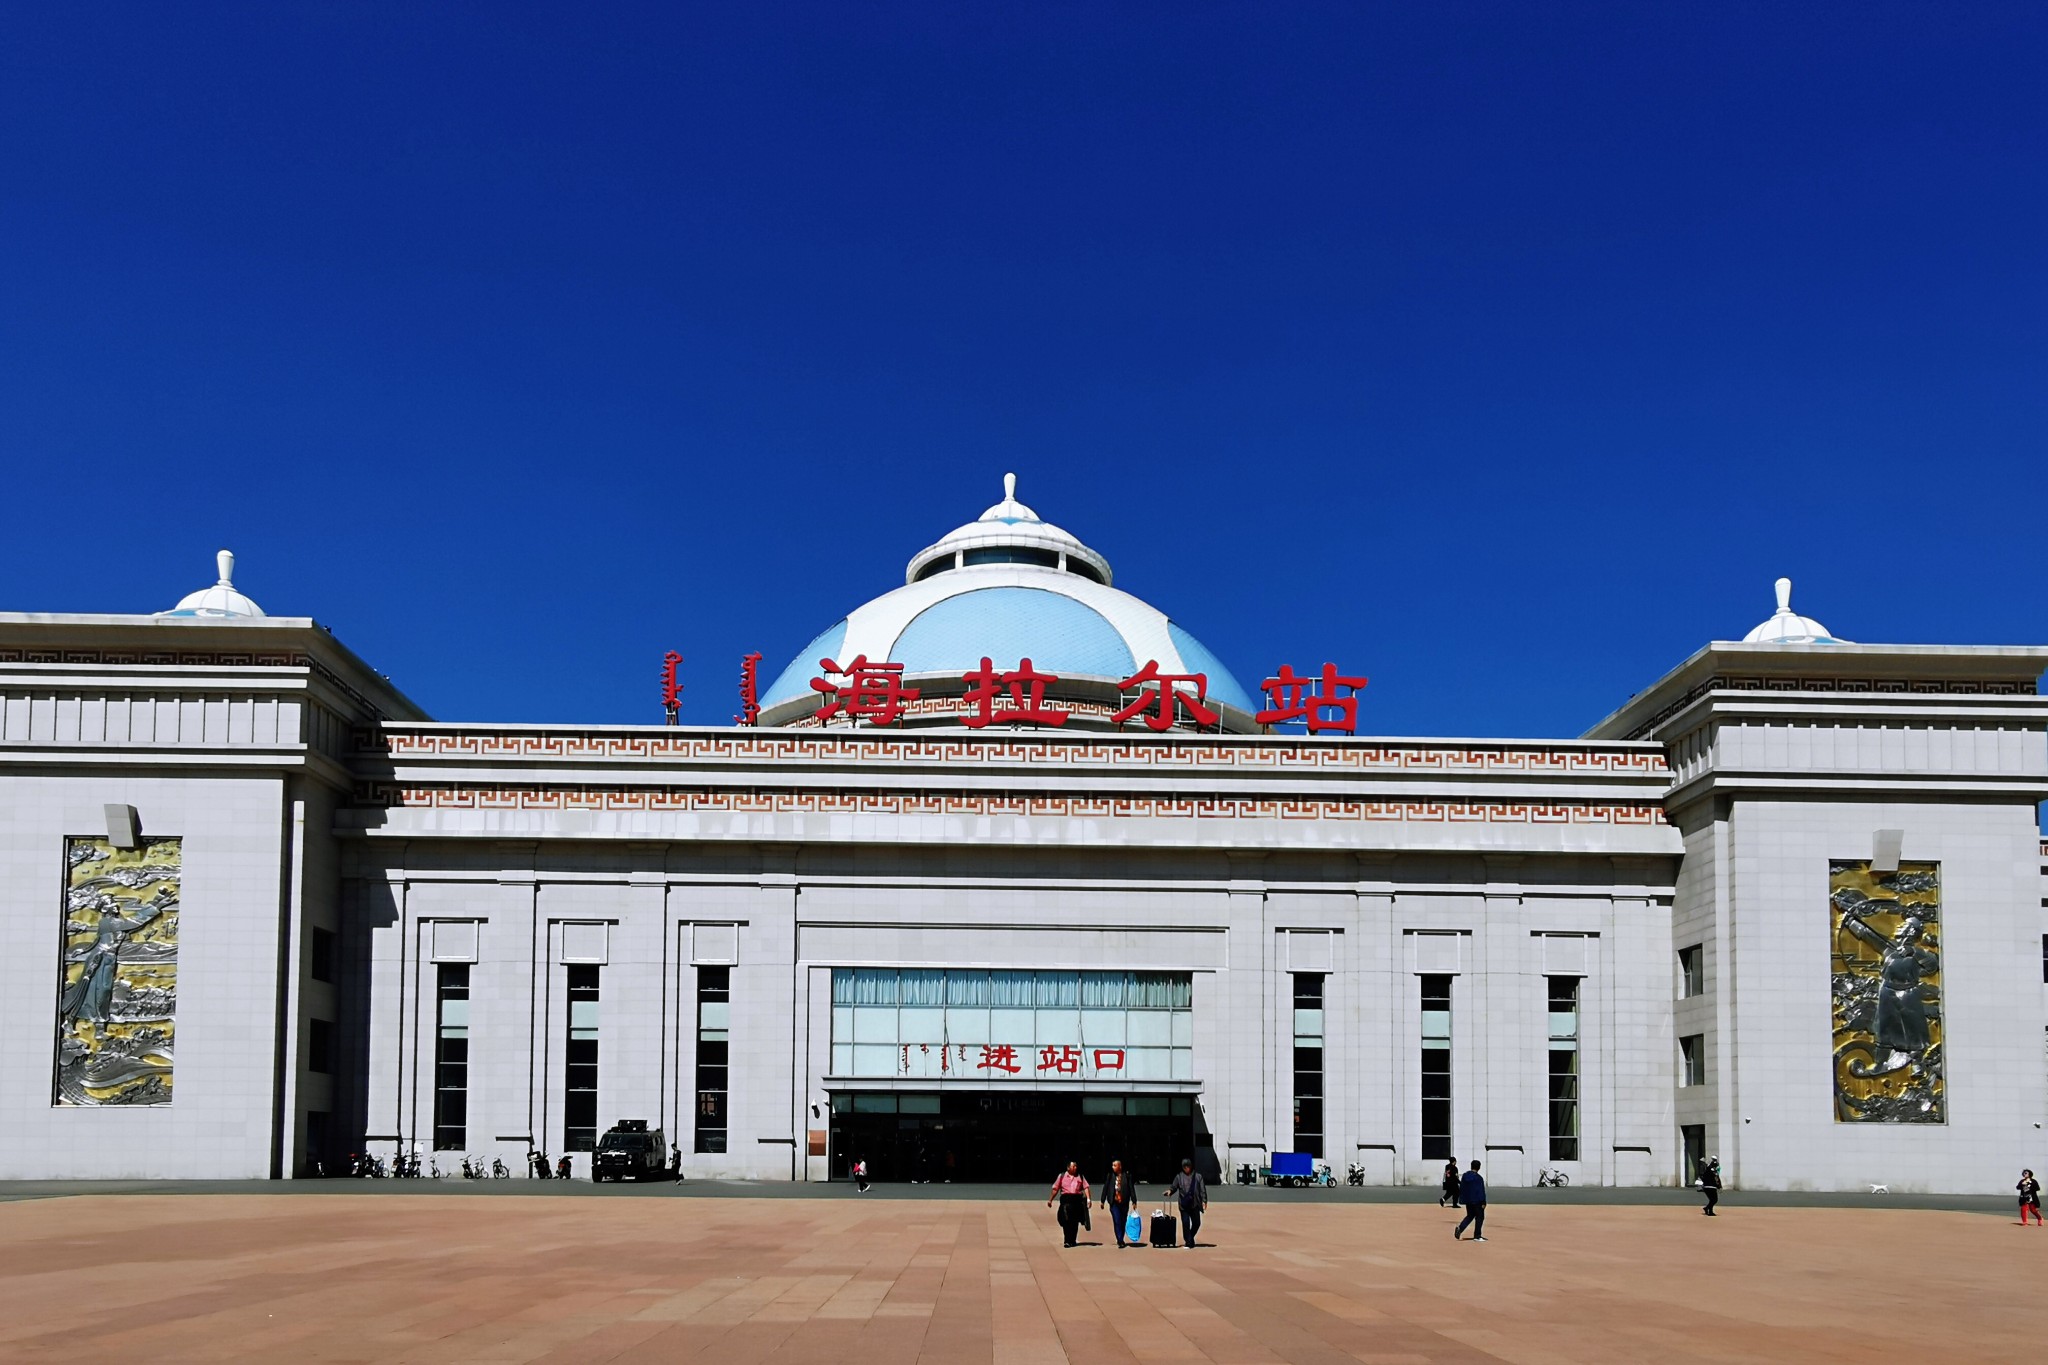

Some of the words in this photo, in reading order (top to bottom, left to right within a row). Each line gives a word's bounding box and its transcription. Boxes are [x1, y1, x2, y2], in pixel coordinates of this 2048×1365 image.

[809, 654, 1368, 731] 海拉尔站
[977, 1044, 1125, 1073] 进站口
